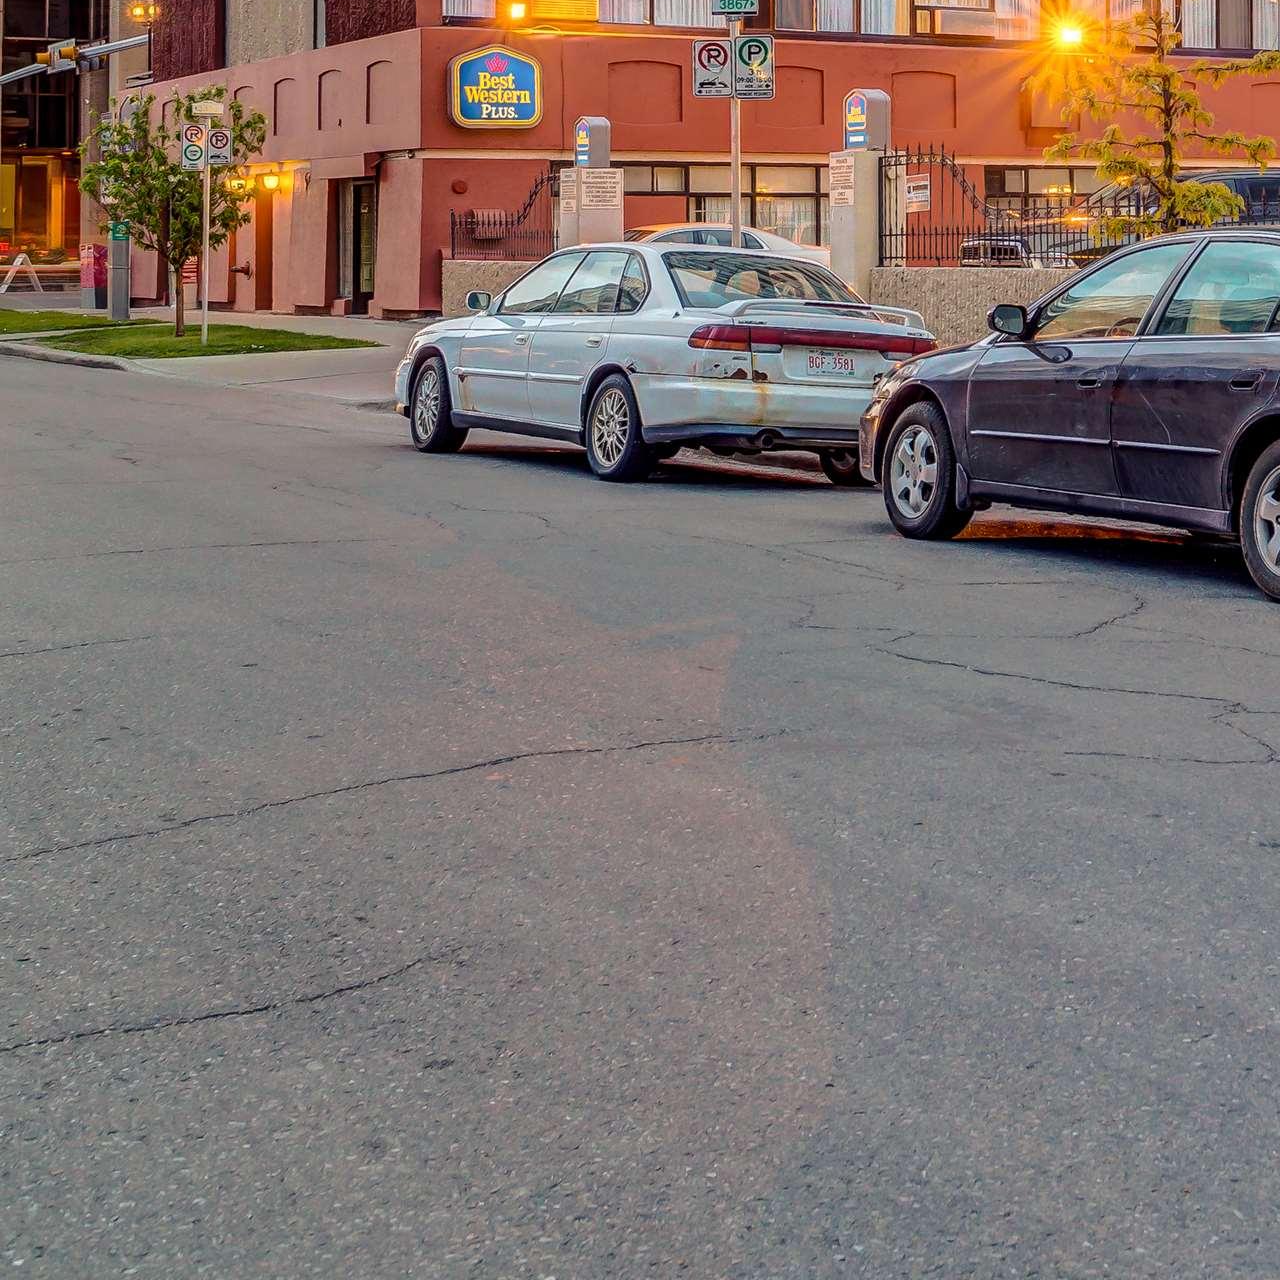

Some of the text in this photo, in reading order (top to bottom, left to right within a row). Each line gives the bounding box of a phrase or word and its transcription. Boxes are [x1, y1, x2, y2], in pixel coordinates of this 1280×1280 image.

[719, 0, 749, 10] 3867
[747, 44, 762, 61] P
[478, 72, 515, 89] Best
[464, 86, 531, 104] Western
